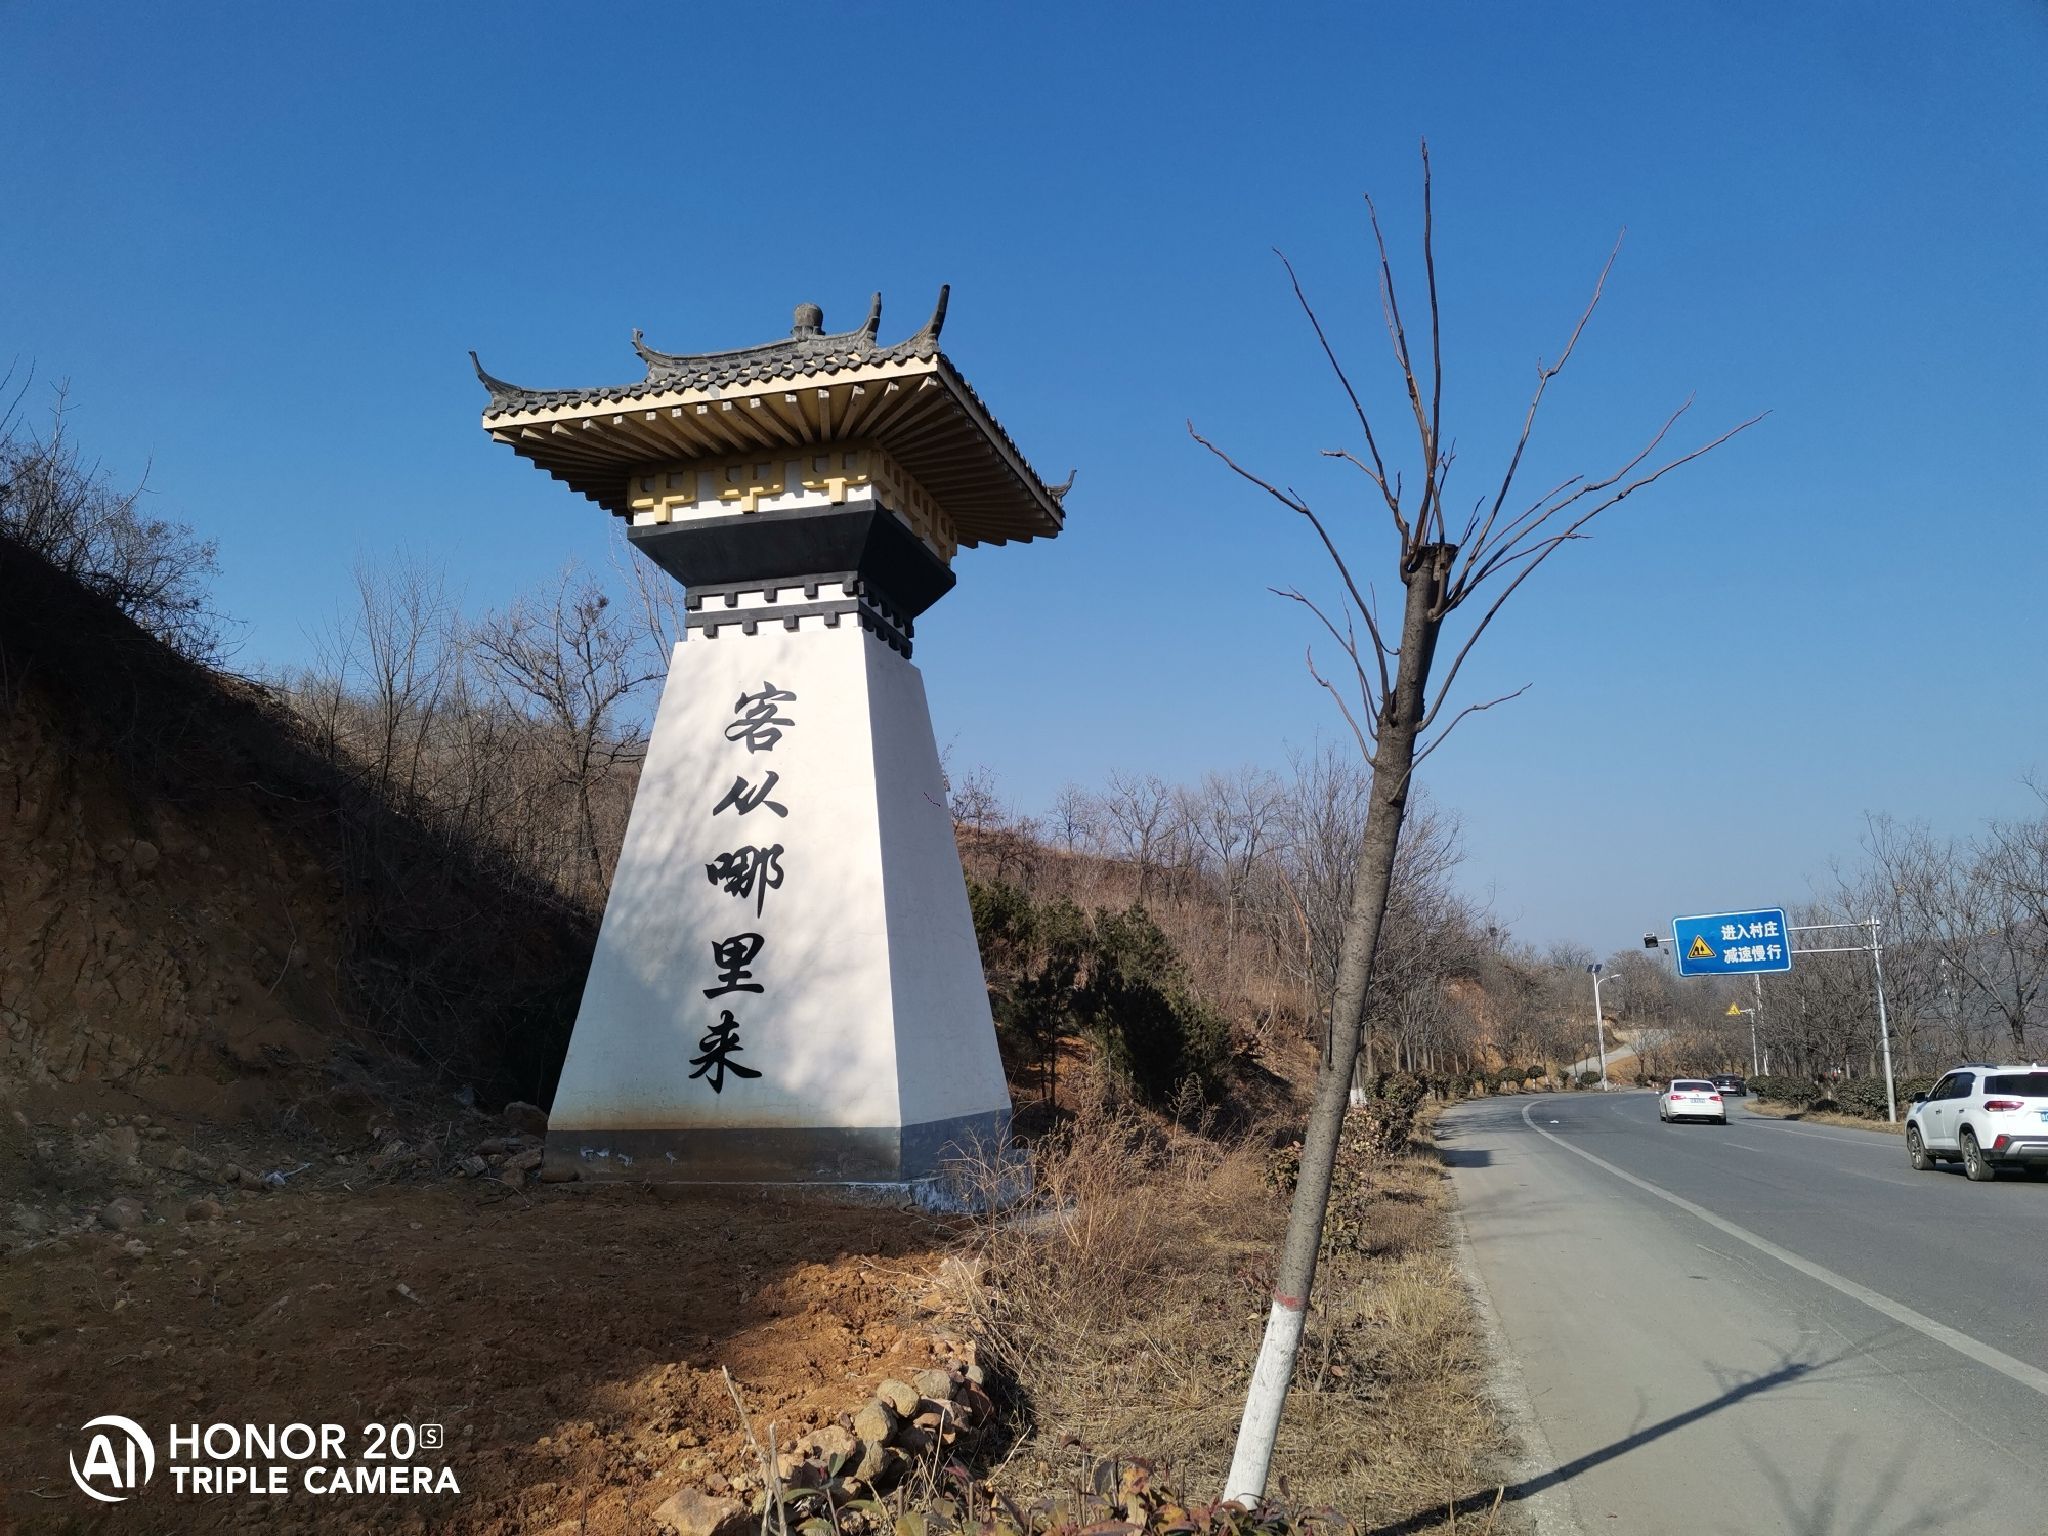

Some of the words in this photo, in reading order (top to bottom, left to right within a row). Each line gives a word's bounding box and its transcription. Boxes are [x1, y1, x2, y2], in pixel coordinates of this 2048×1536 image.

[688, 681, 797, 1094] 客从哪里来
[1721, 921, 1780, 941] 进入村庄
[1723, 944, 1782, 964] 减速慢行
